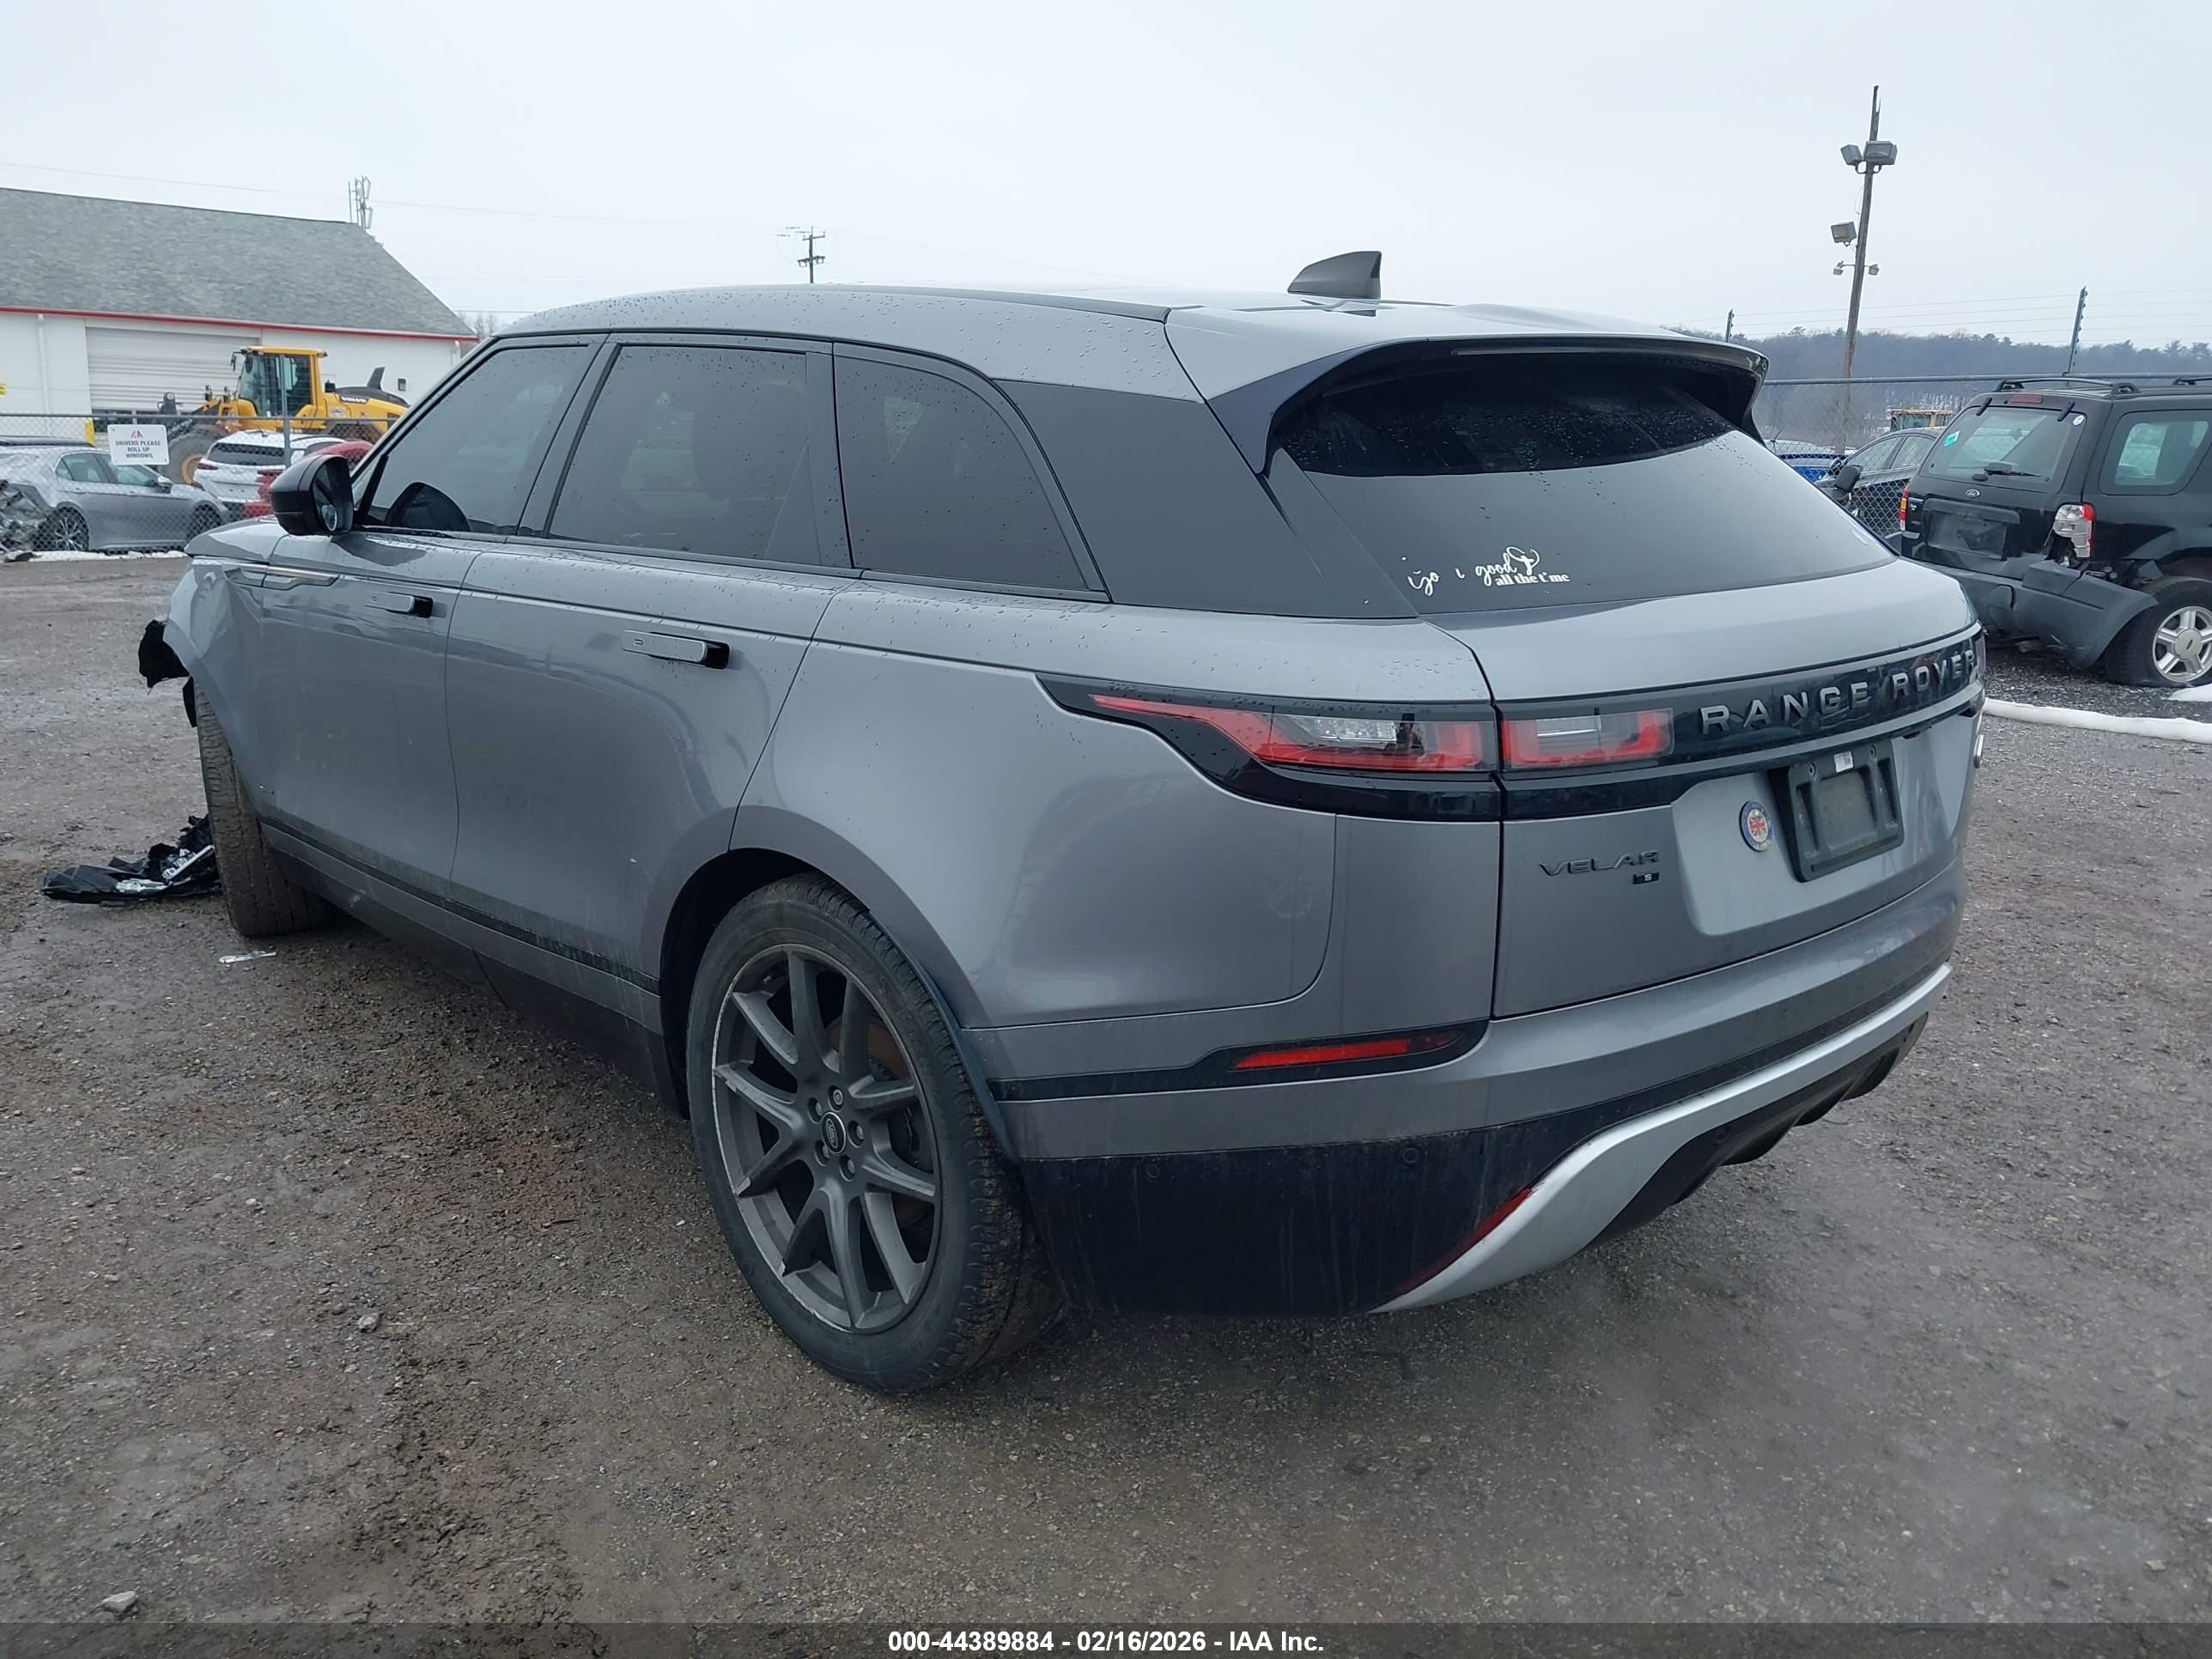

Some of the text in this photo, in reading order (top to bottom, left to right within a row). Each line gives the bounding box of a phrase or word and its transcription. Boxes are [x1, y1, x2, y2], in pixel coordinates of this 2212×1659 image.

[1474, 552, 1517, 586] good
[1495, 572, 1515, 586] all
[1699, 649, 1975, 734] RANGE ROVER
[1539, 849, 1659, 876] VELAR
